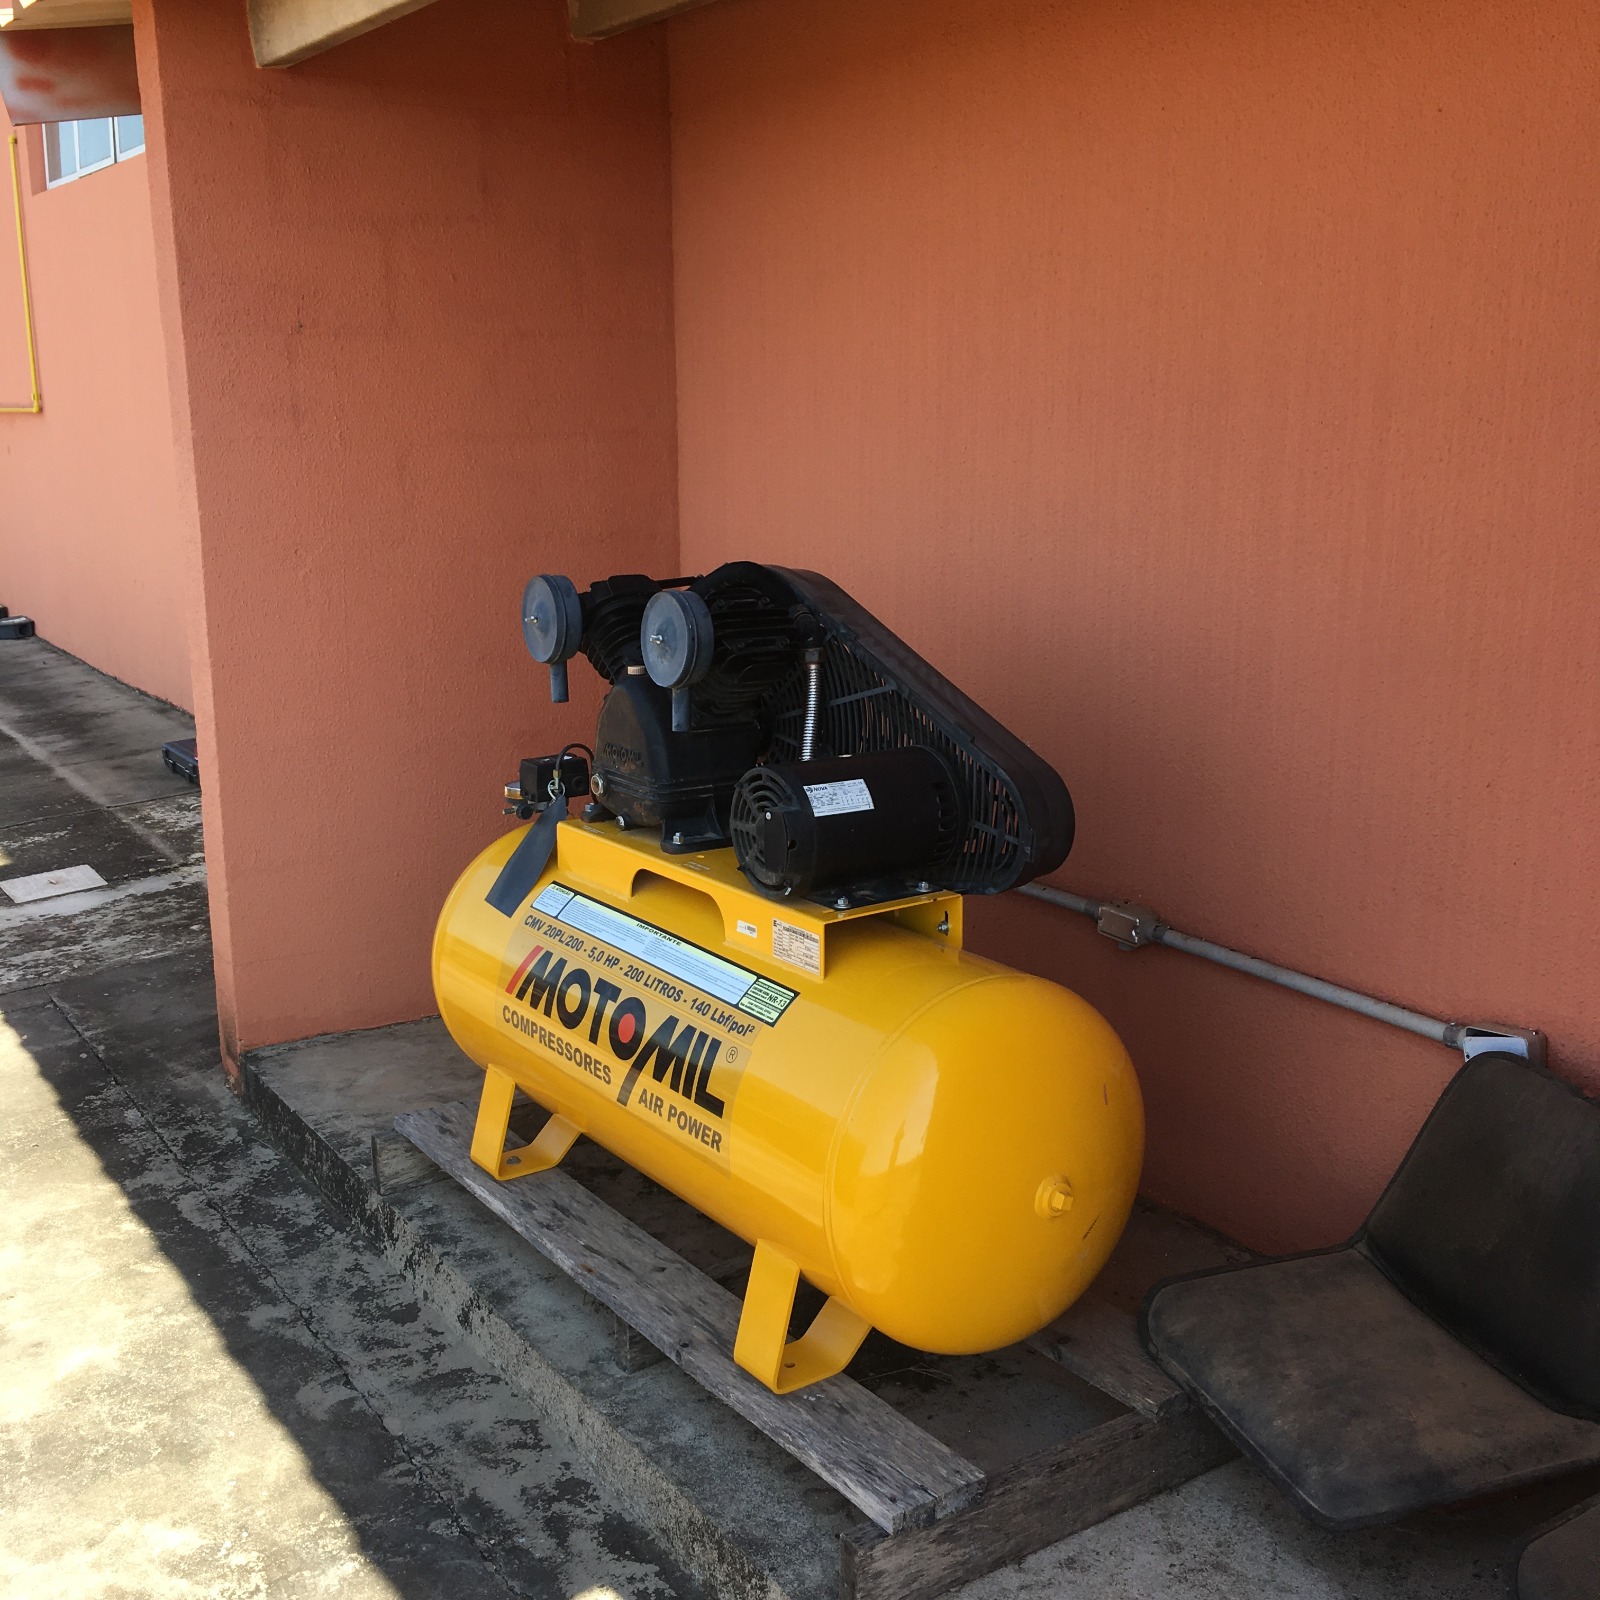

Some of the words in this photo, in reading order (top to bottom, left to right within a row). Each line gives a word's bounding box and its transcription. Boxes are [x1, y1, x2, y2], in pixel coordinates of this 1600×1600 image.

[524, 914, 546, 931] CMV
[543, 925, 584, 951] 20PL/200
[588, 946, 605, 962] 5,0
[604, 953, 620, 968] HP
[623, 964, 645, 982] 200
[643, 973, 684, 1003] LITROS
[687, 997, 711, 1016] 140
[636, 922, 683, 946] IMPORTANTE
[515, 949, 725, 1119] MOTOMIL
[767, 993, 787, 1008] NR-13
[502, 1004, 612, 1085] COMPRESSORES
[638, 1088, 664, 1117] AIR
[667, 1103, 723, 1153] POWER
